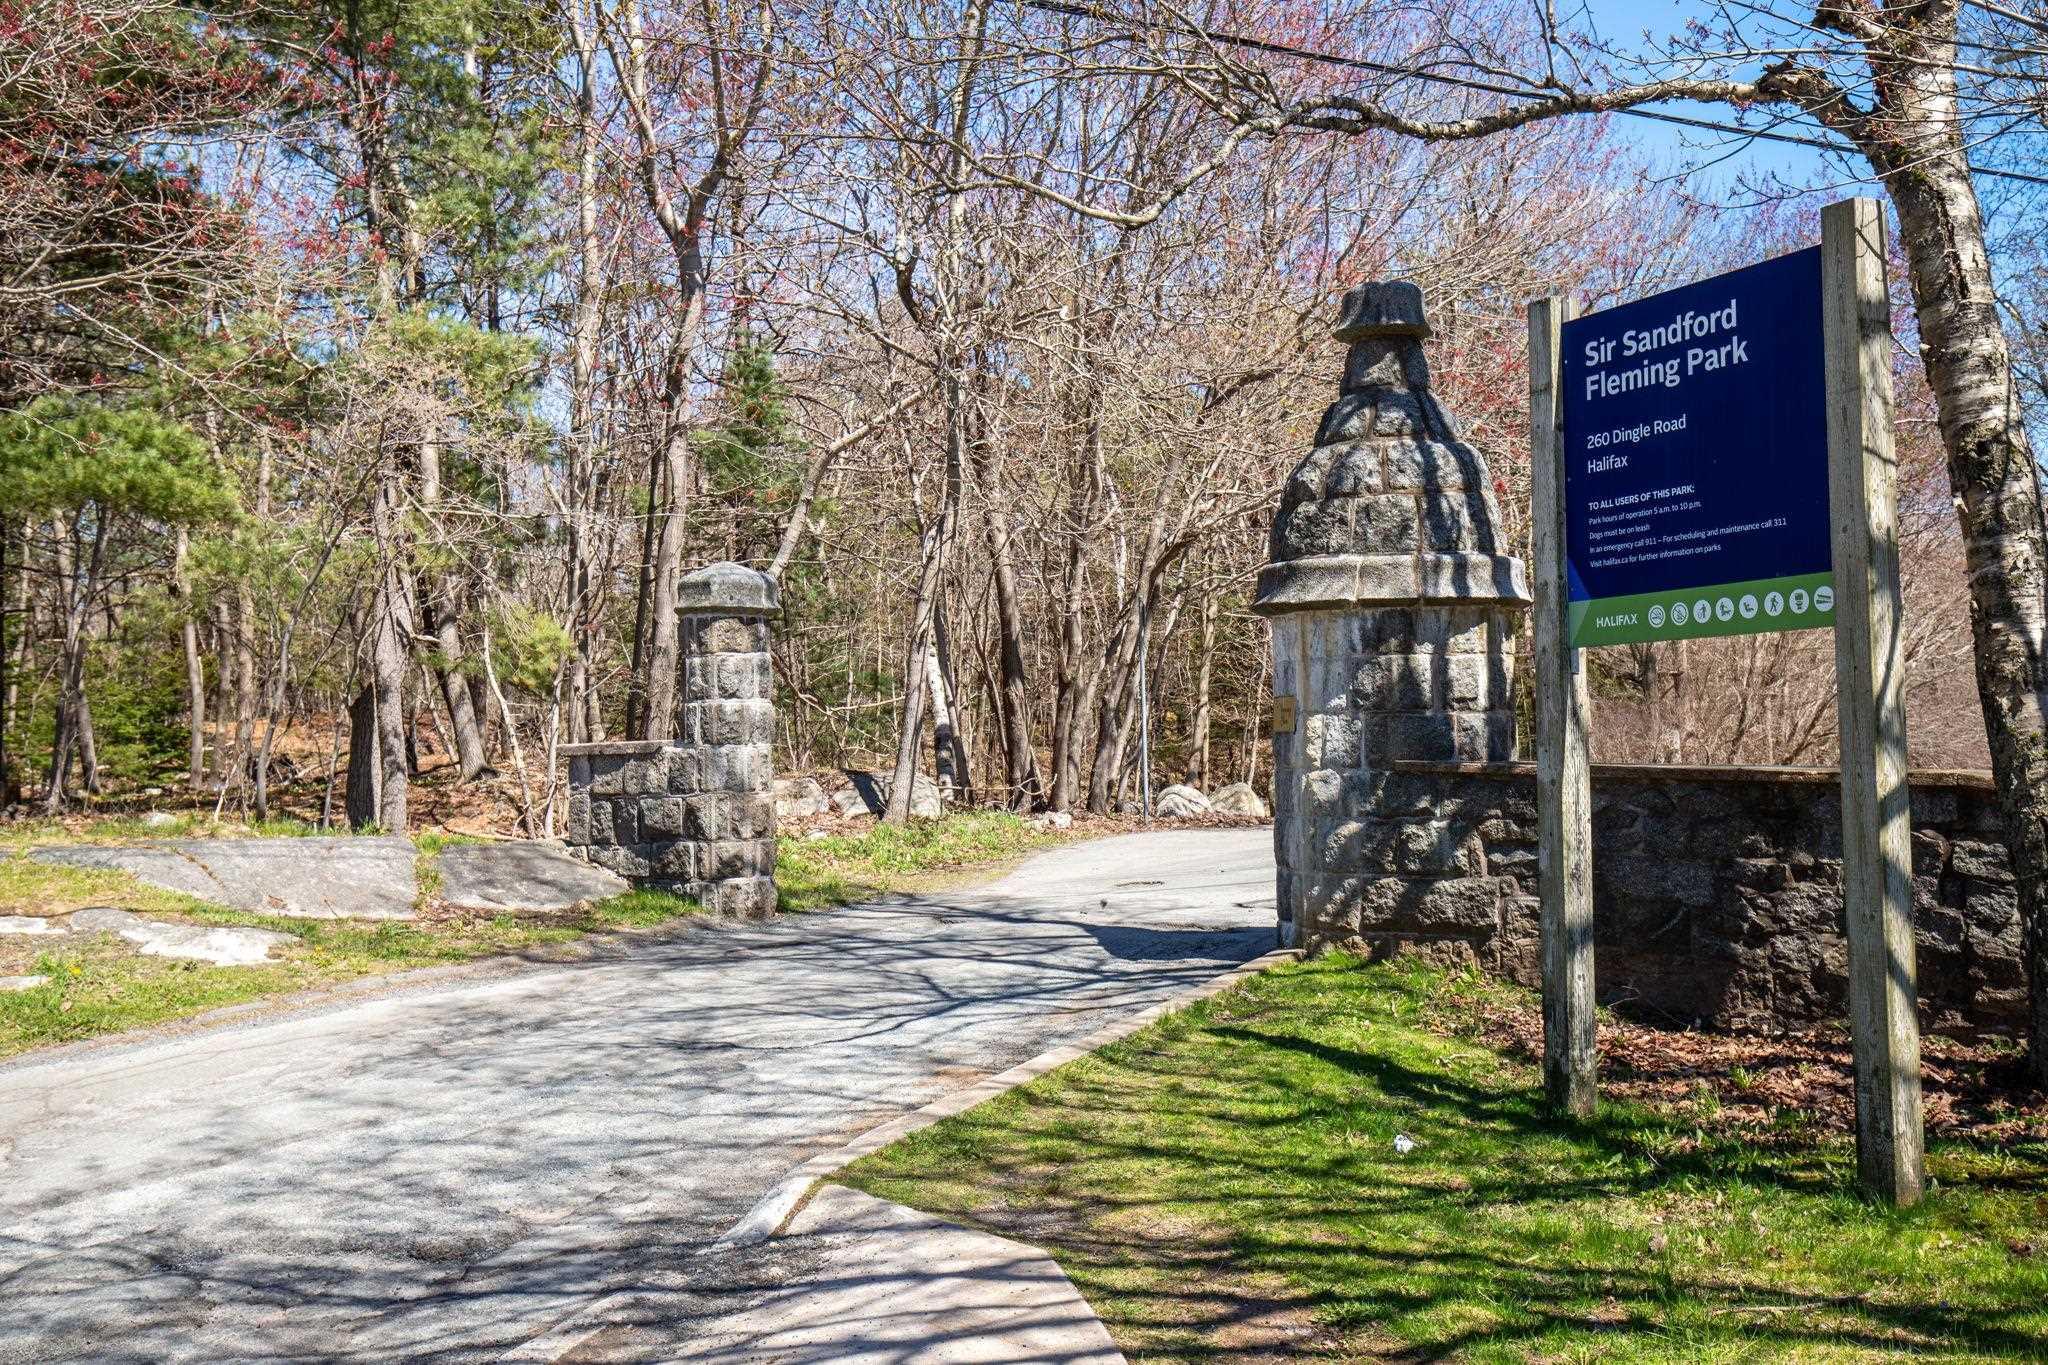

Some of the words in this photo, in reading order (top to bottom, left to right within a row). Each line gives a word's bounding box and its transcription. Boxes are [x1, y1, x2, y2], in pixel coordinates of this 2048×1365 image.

[1585, 337, 1616, 366] Sir
[1622, 299, 1737, 356] Sandford
[1586, 359, 1680, 400] Fleming
[1687, 336, 1748, 375] Park
[1587, 432, 1609, 449] 260
[1612, 424, 1650, 442] Dingle
[1654, 414, 1686, 434] Road
[1588, 454, 1628, 473] Halifax
[1588, 502, 1599, 510] TO
[1600, 499, 1614, 508] ALL
[1615, 494, 1639, 505] USERS
[1640, 492, 1651, 501] OF
[1652, 489, 1670, 499] THIS
[1671, 485, 1695, 496] PARK:
[1589, 516, 1601, 525] Park
[1619, 512, 1625, 520] of
[1626, 509, 1653, 520] operation
[1654, 507, 1658, 515] 5
[1680, 502, 1688, 510] 10
[1589, 532, 1603, 540] Dogs
[1604, 529, 1618, 537] must
[1603, 542, 1633, 552] emergency
[1634, 539, 1644, 547] call
[1645, 537, 1657, 545] 911
[1674, 530, 1706, 542] scheduling
[1706, 528, 1718, 536] and
[1719, 524, 1760, 534] maintenance
[1760, 519, 1772, 529] call
[1774, 517, 1787, 527] 311
[1629, 555, 1637, 563] for
[1638, 552, 1658, 561] further
[1660, 548, 1694, 559] information
[1703, 544, 1721, 554] parks
[1596, 613, 1638, 628] HALIFAX
